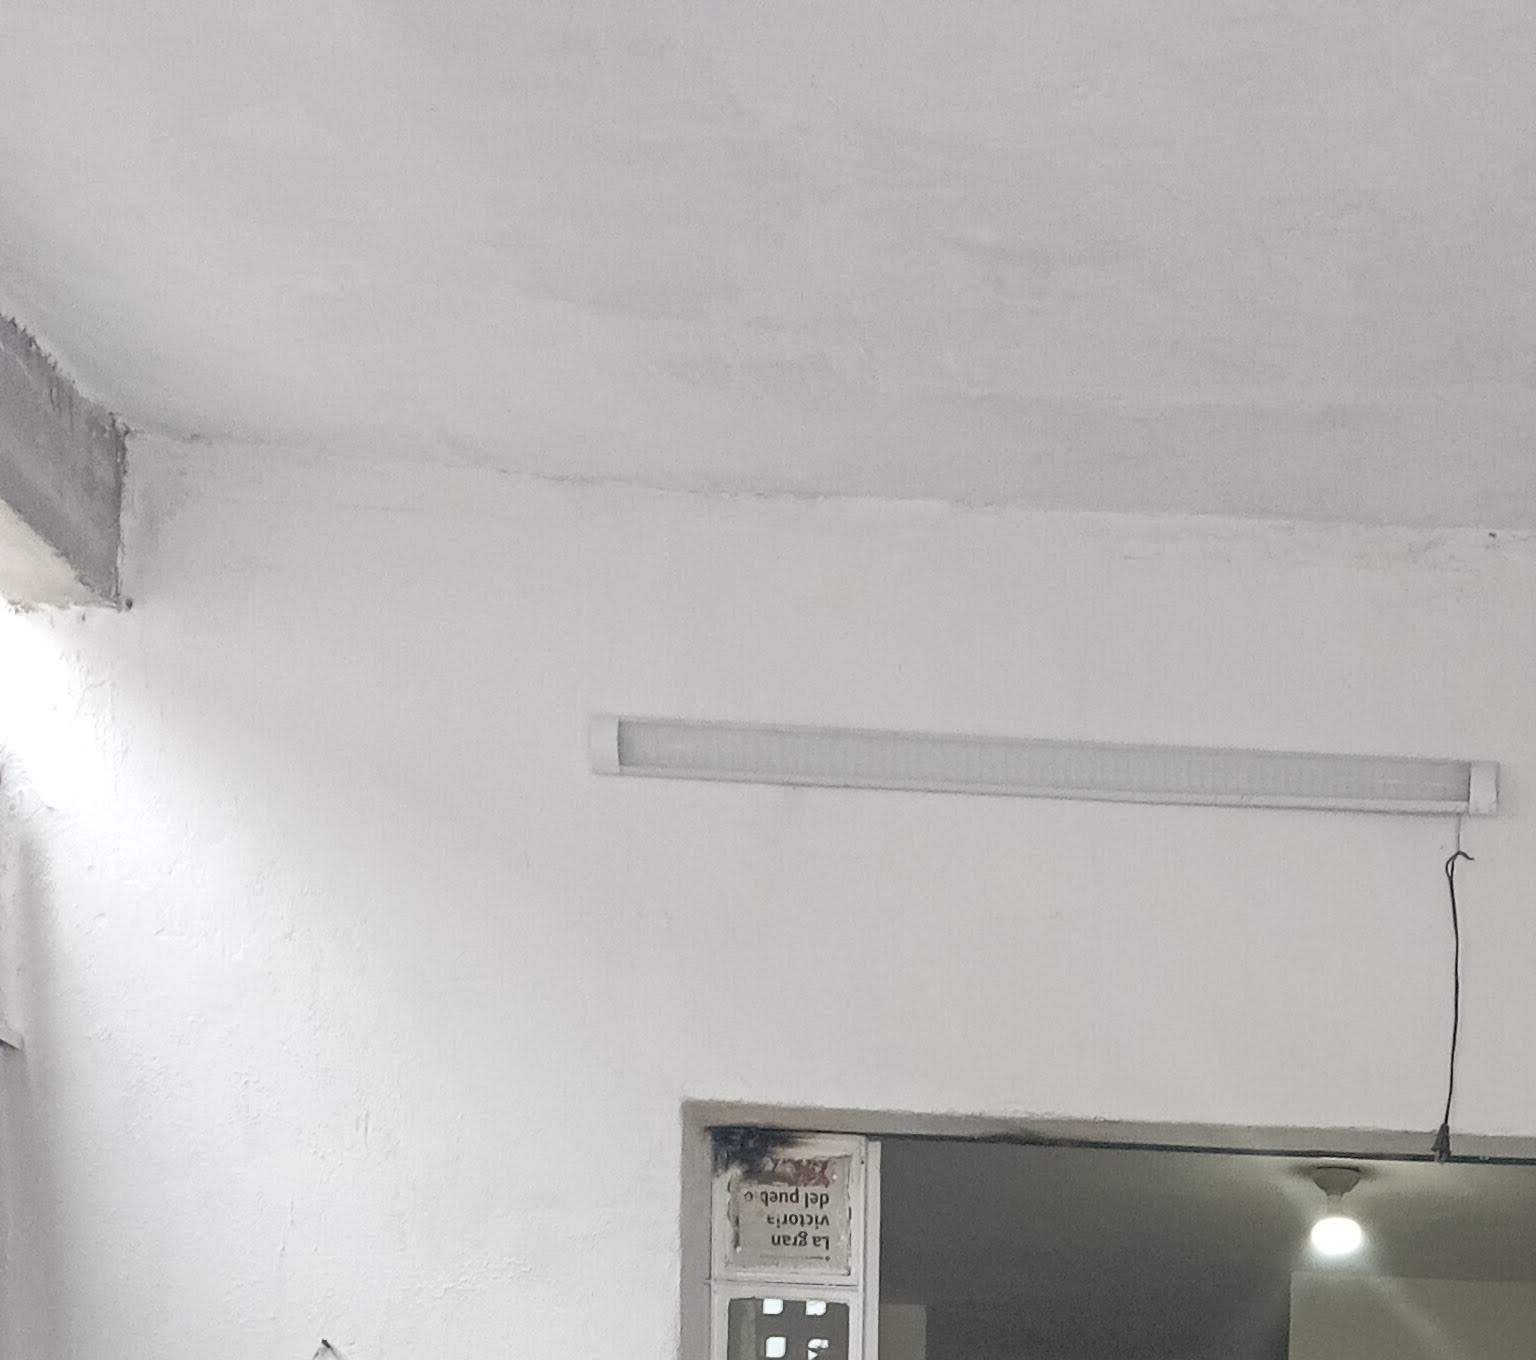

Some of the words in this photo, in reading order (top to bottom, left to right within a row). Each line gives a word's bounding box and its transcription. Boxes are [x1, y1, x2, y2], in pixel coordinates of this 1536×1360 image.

[743, 1187, 800, 1207] puebo
[804, 1191, 829, 1210] del
[771, 1231, 808, 1247] gran
[812, 1235, 829, 1251] La
